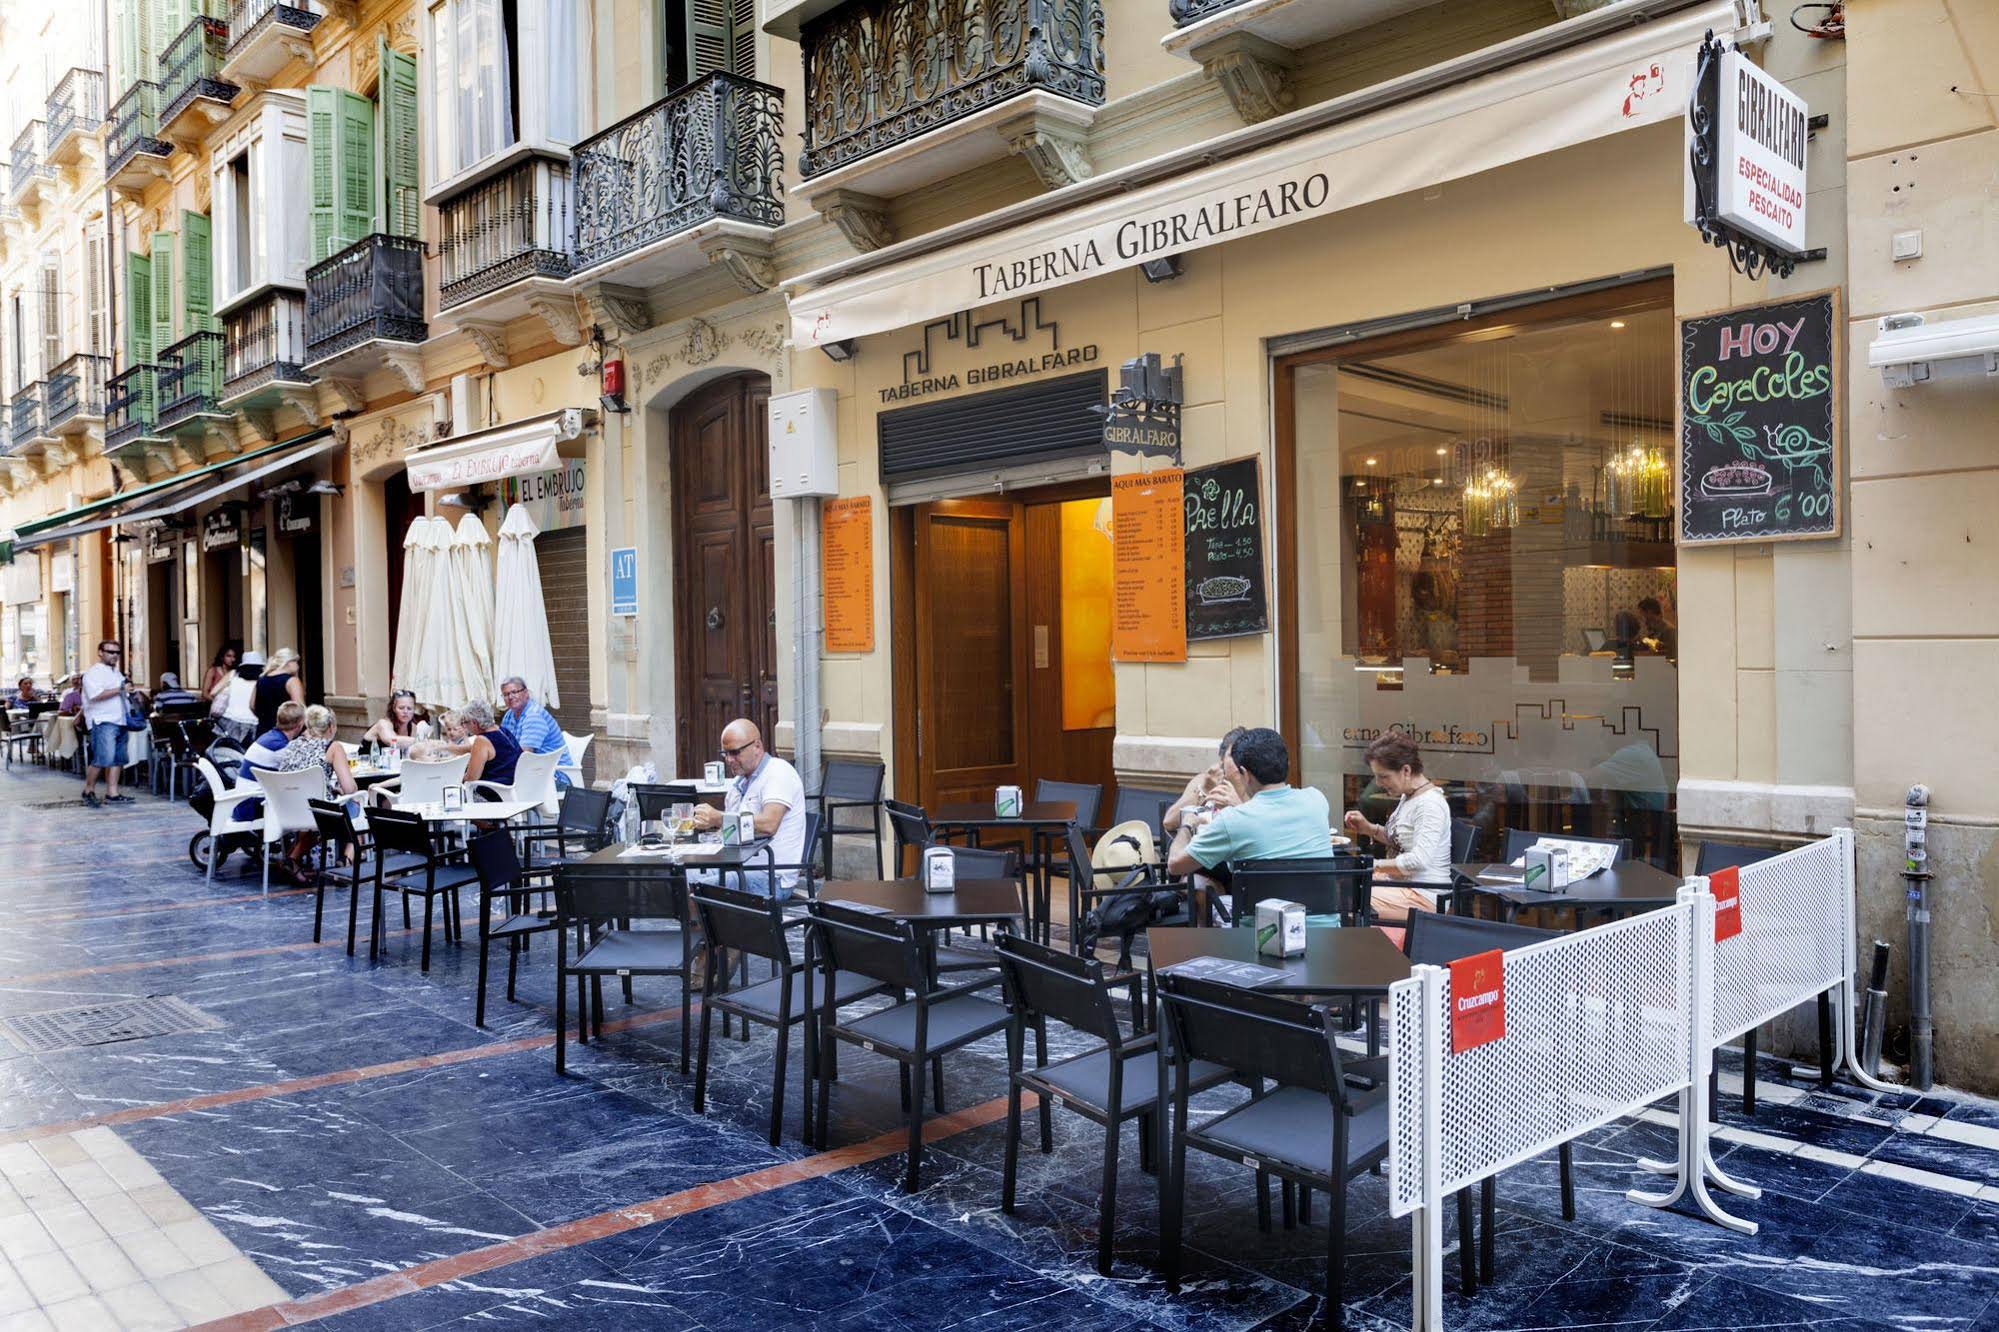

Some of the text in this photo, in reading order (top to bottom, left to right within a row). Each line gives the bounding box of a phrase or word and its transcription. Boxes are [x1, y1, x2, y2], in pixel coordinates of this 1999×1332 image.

[1738, 68, 1805, 171] GIBRALFARO
[1738, 156, 1802, 209] ESPECIALIDAD
[1749, 190, 1793, 229] PESCAITO
[973, 173, 1330, 299] TABERNA GIBRALFARO
[1719, 317, 1806, 361] HOY
[879, 344, 1098, 404] TABERNA GIBRALFARO
[1104, 426, 1177, 447] GIBRALFARO
[522, 468, 585, 502] EL EMBRUJO
[1152, 474, 1182, 485] BARATO
[1458, 990, 1498, 1011] Cruzcampo
